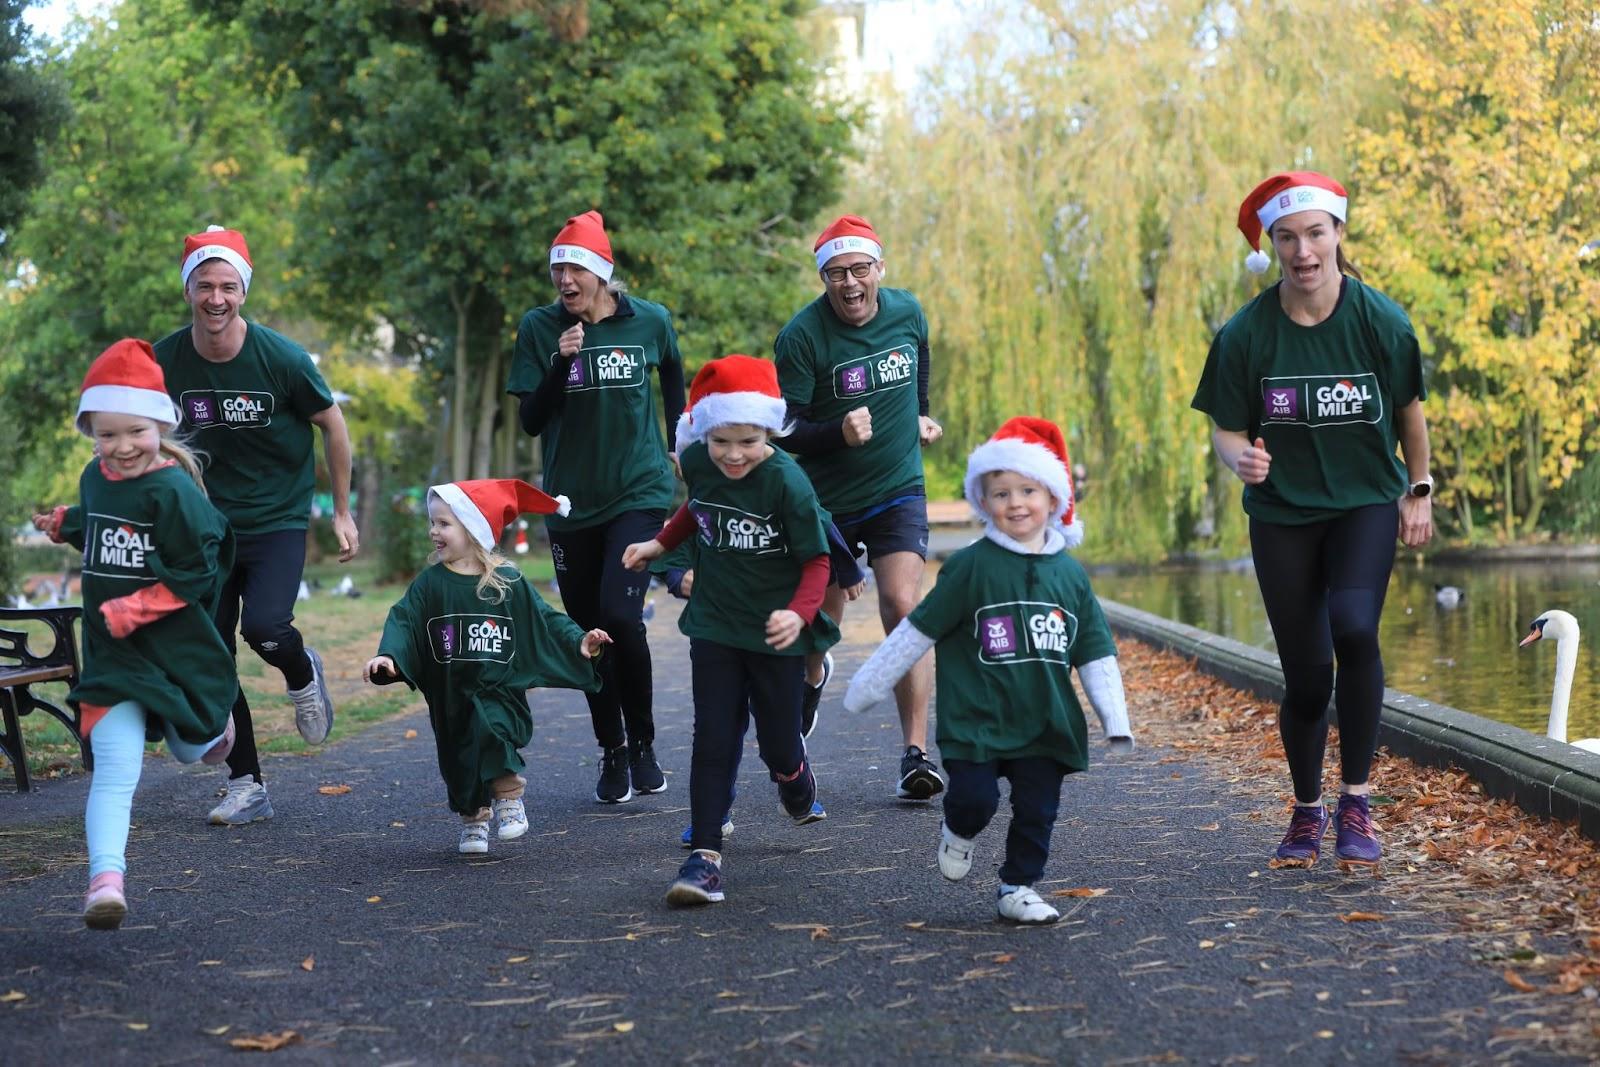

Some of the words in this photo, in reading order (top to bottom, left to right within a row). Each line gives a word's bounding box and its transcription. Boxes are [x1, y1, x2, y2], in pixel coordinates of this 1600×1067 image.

[597, 350, 639, 367] GOAL
[877, 352, 914, 372] GOAL
[599, 366, 632, 380] MILE
[880, 365, 911, 384] MILE
[848, 381, 863, 390] AIB
[1316, 383, 1372, 403] GOAL
[222, 397, 265, 412] GOAL
[1272, 406, 1292, 415] AIB
[1317, 401, 1363, 417] MILE
[194, 411, 209, 419] AIB
[224, 410, 259, 422] MILE
[726, 517, 779, 538] GOAL
[101, 527, 156, 551] GOAL
[729, 532, 770, 549] MILE
[100, 546, 145, 568] MILE
[468, 620, 512, 641] GOAL
[467, 637, 503, 653] MILE
[989, 637, 1010, 650] AIB
[1031, 631, 1069, 653] MILE
